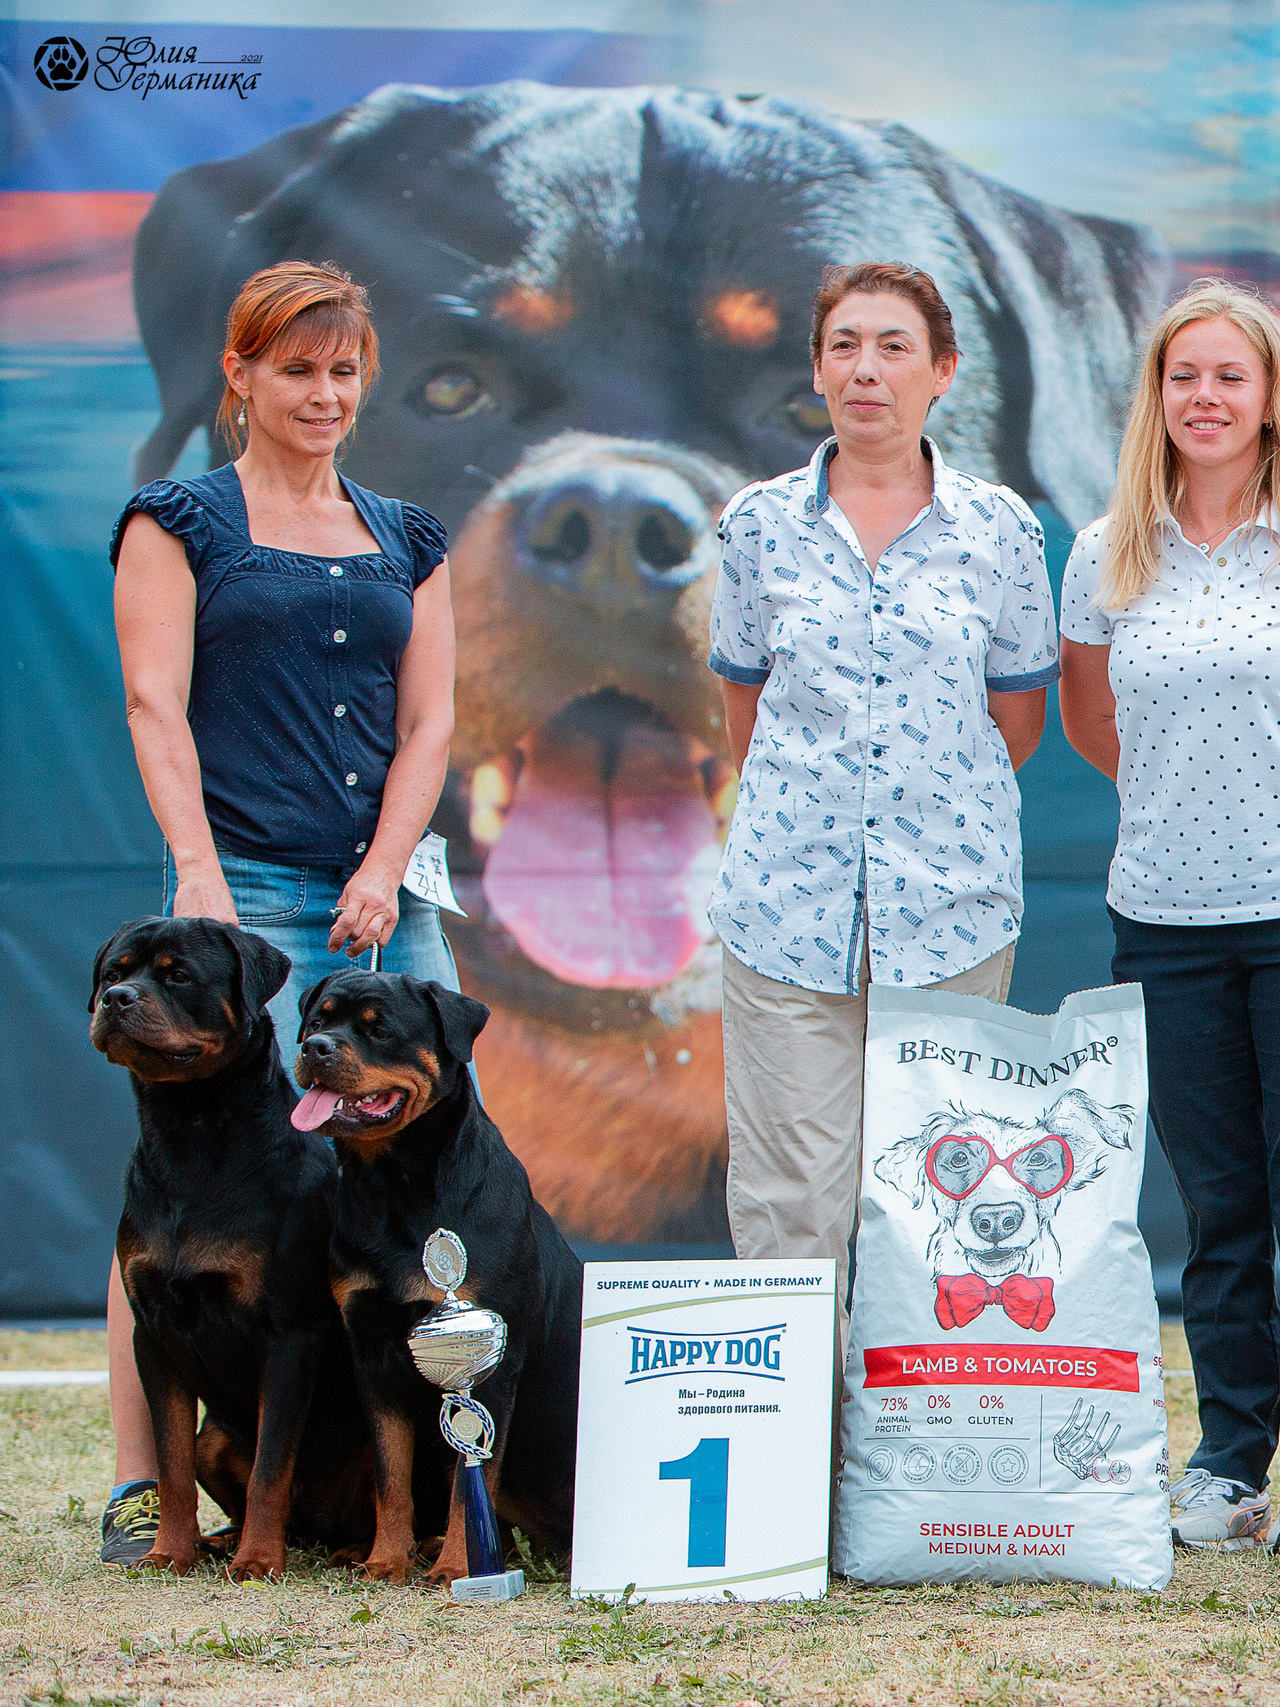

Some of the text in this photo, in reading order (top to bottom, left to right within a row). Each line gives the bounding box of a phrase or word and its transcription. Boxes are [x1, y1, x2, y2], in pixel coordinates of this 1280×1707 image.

[897, 1039, 1112, 1088] BEST DINNER
[597, 1276, 823, 1290] SUPREME QUALITY MADE IN GERMANY
[629, 1333, 782, 1375] HAPPY DOG
[902, 1356, 1097, 1377] LAMB & TOMATOES
[678, 1388, 697, 1399] Мы
[706, 1388, 746, 1400] Родина
[881, 1397, 908, 1411] 73%
[927, 1394, 951, 1409] 0%
[979, 1394, 1004, 1410] 0%
[678, 1403, 782, 1416] здорового питания.
[877, 1415, 910, 1424] ANIMAL
[927, 1416, 953, 1425] GMO
[967, 1416, 1014, 1426] GLUTEN
[874, 1424, 911, 1434] PROTEIN
[659, 1438, 730, 1567] 1
[920, 1523, 1075, 1538] SENSIBLE ADULT
[929, 1542, 1066, 1557] MEDIUM & MAXI
